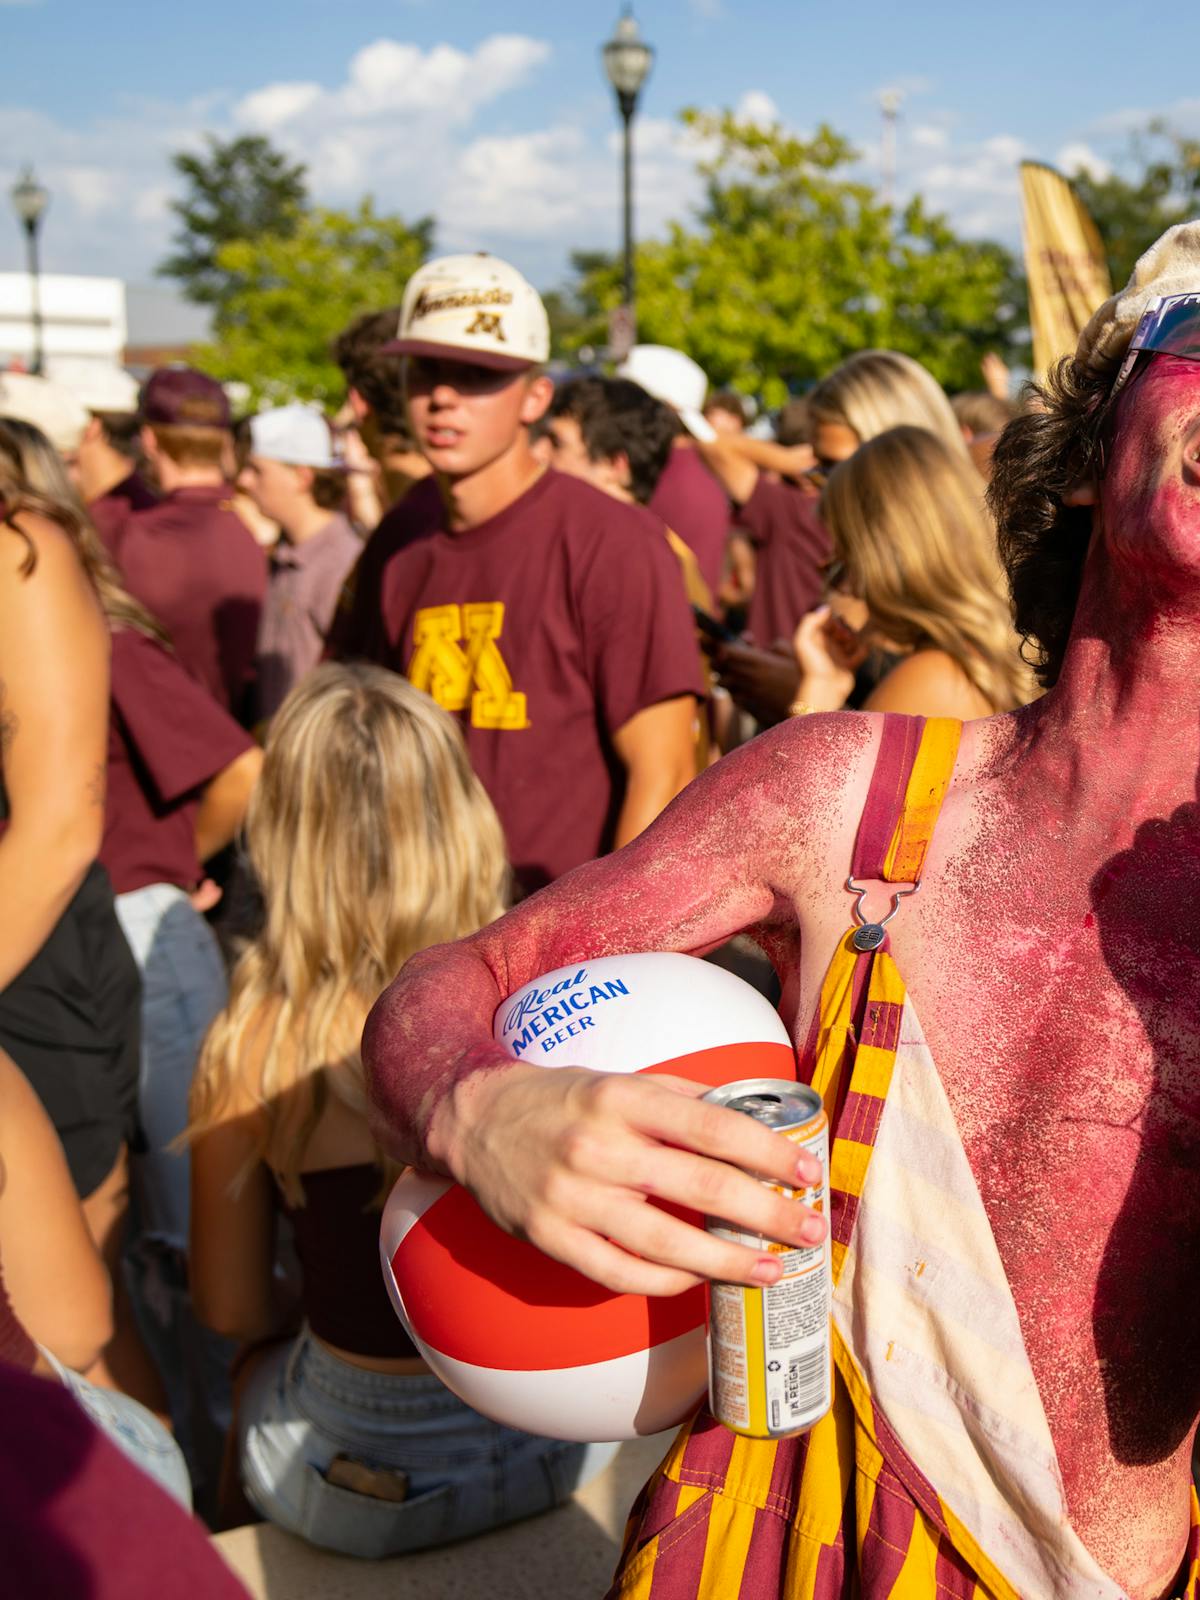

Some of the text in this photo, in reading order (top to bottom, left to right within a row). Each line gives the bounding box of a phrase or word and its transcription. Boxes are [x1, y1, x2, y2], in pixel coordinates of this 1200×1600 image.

[464, 311, 507, 342] M
[407, 601, 527, 730] M
[503, 968, 589, 1036] Real
[511, 978, 631, 1057] MERICAN
[540, 1016, 597, 1053] BEER
[788, 1364, 800, 1399] REIGN
